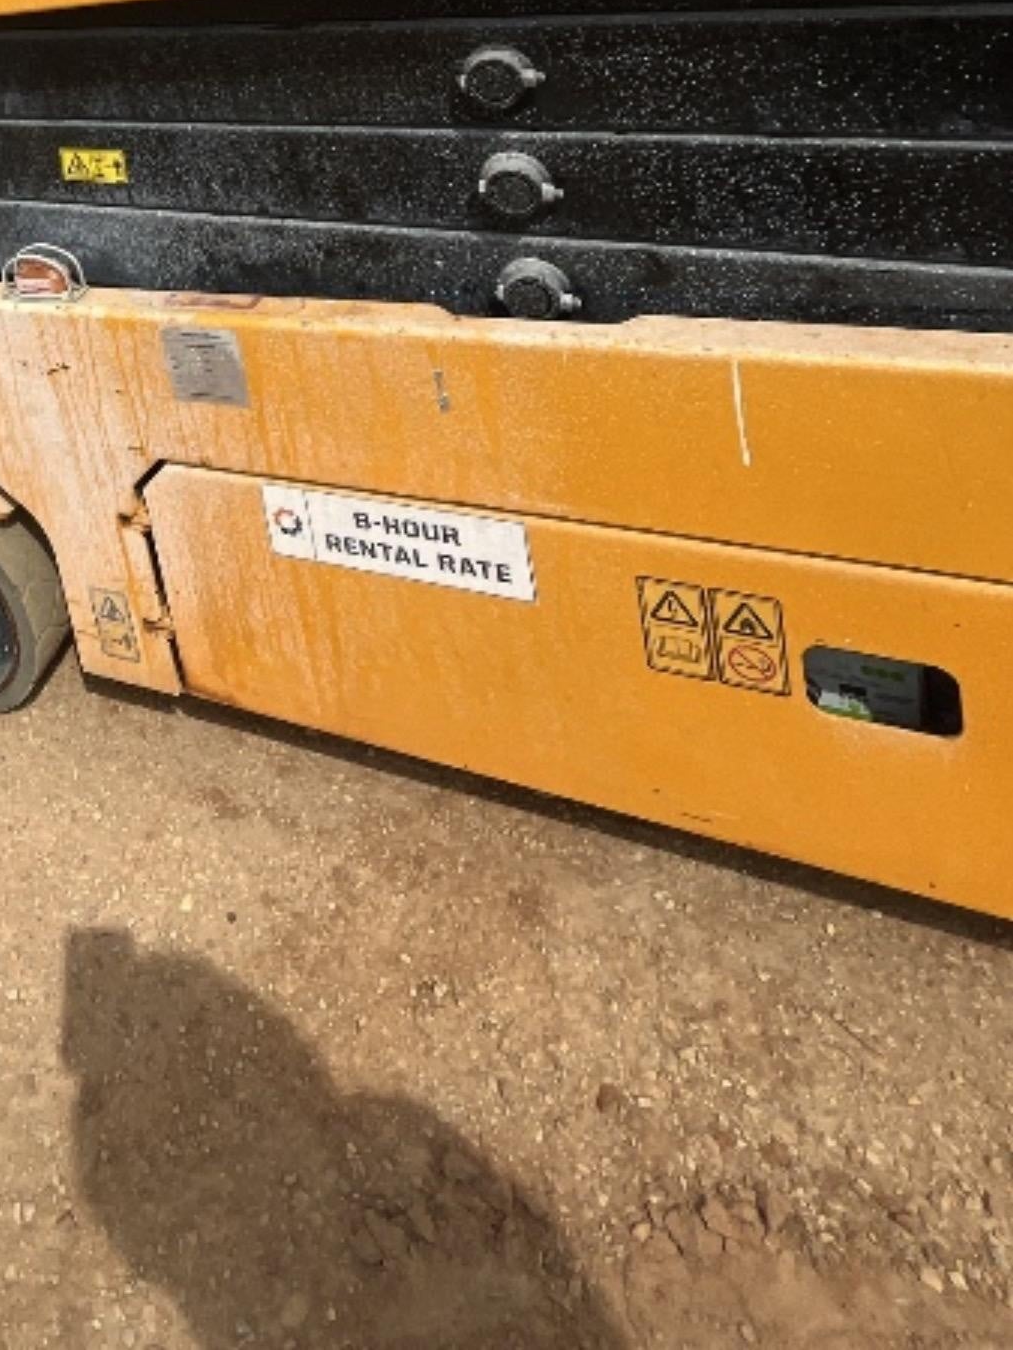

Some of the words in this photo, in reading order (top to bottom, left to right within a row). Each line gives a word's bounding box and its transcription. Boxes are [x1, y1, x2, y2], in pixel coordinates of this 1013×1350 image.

[352, 511, 462, 547] 8-HOUR
[324, 532, 429, 569] RENTAL
[438, 552, 513, 584] RATE
